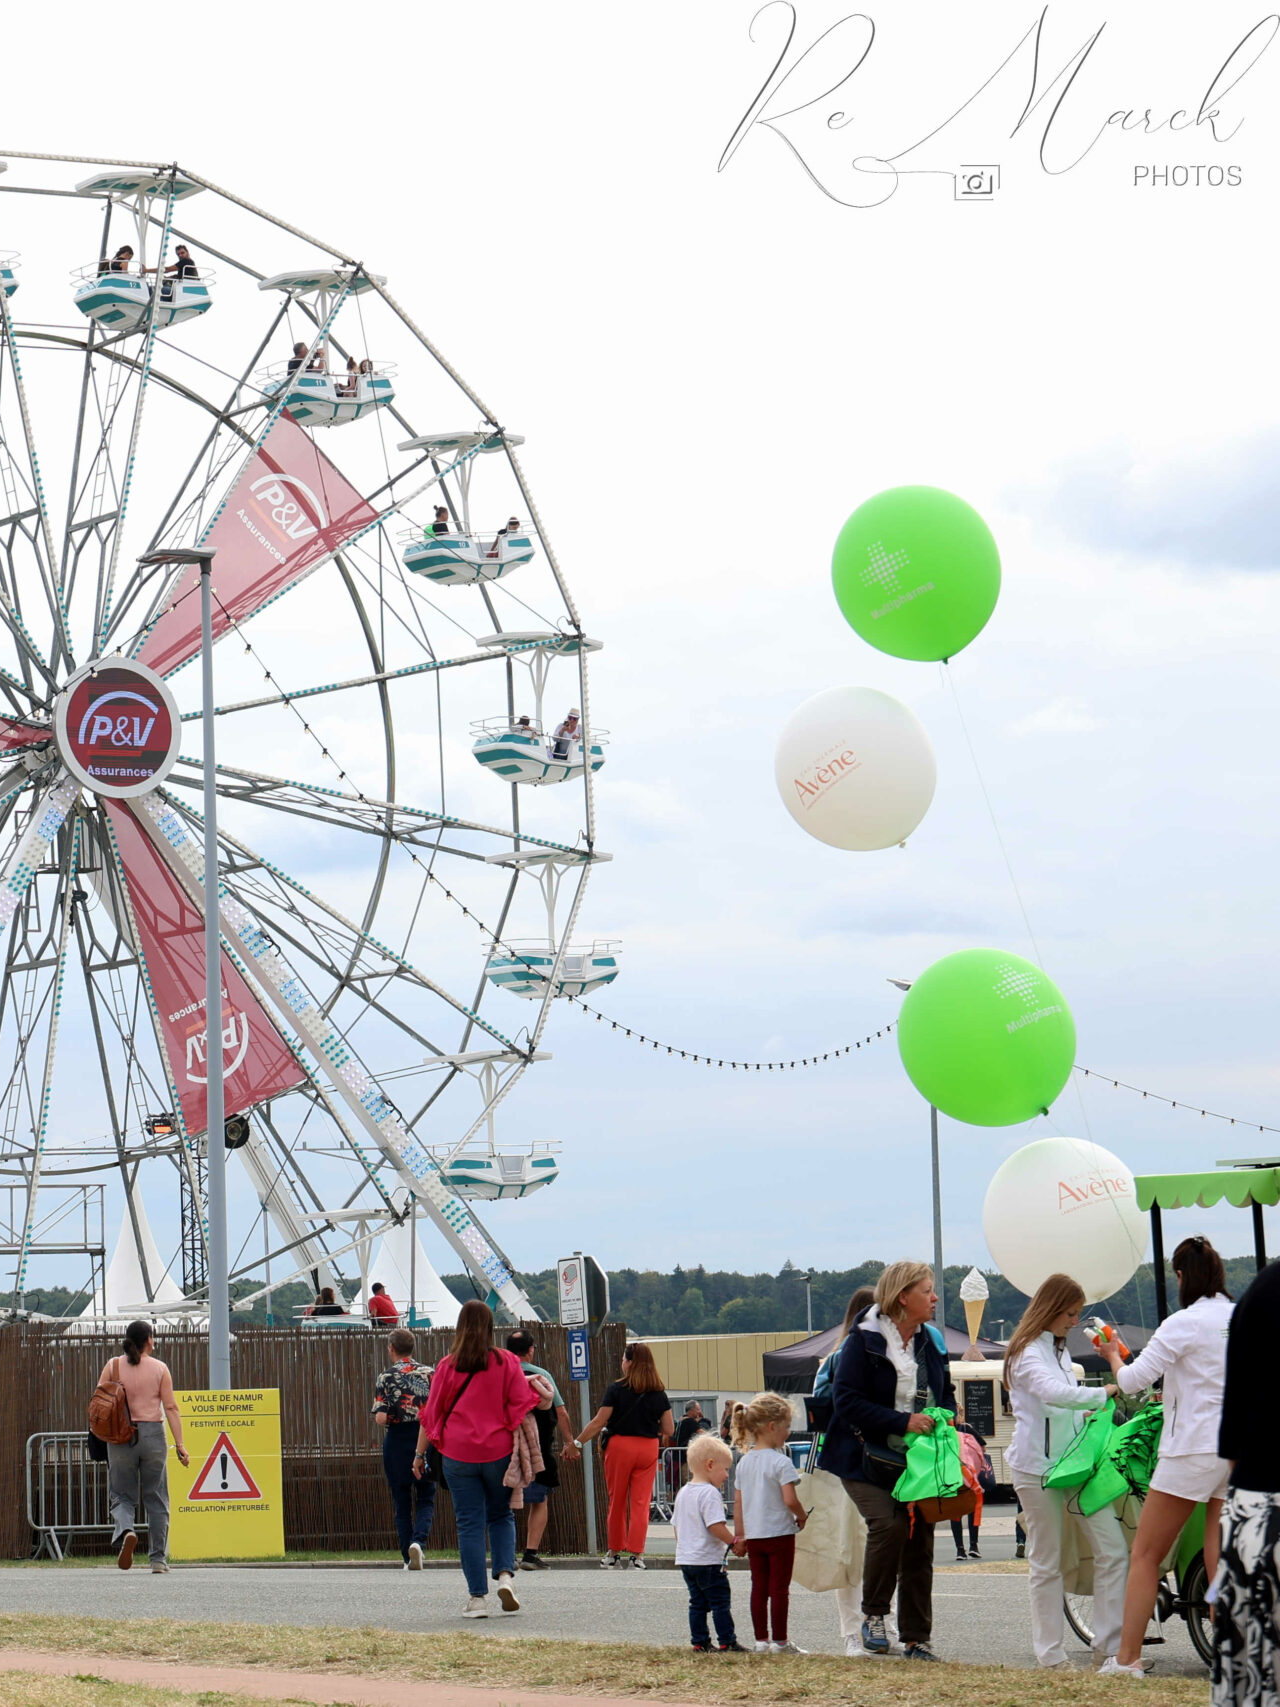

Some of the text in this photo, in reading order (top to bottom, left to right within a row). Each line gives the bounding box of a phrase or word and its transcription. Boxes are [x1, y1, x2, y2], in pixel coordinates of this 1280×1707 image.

[256, 482, 319, 540] P&V
[236, 508, 287, 565] Assurances
[89, 715, 156, 746] P&V
[87, 764, 154, 777] Assurances
[794, 749, 857, 807] Avène
[168, 988, 228, 1022] Aurances
[1058, 1177, 1129, 1210] Avène
[575, 1345, 583, 1364] P
[195, 1394, 218, 1402] VILLE
[220, 1394, 231, 1402] DE
[233, 1393, 263, 1401] NAMUR
[217, 1404, 254, 1412] INFORME
[190, 1419, 225, 1428] FESTIVITÉ
[178, 1503, 270, 1513] CIRCULATION PERTURBÉE
